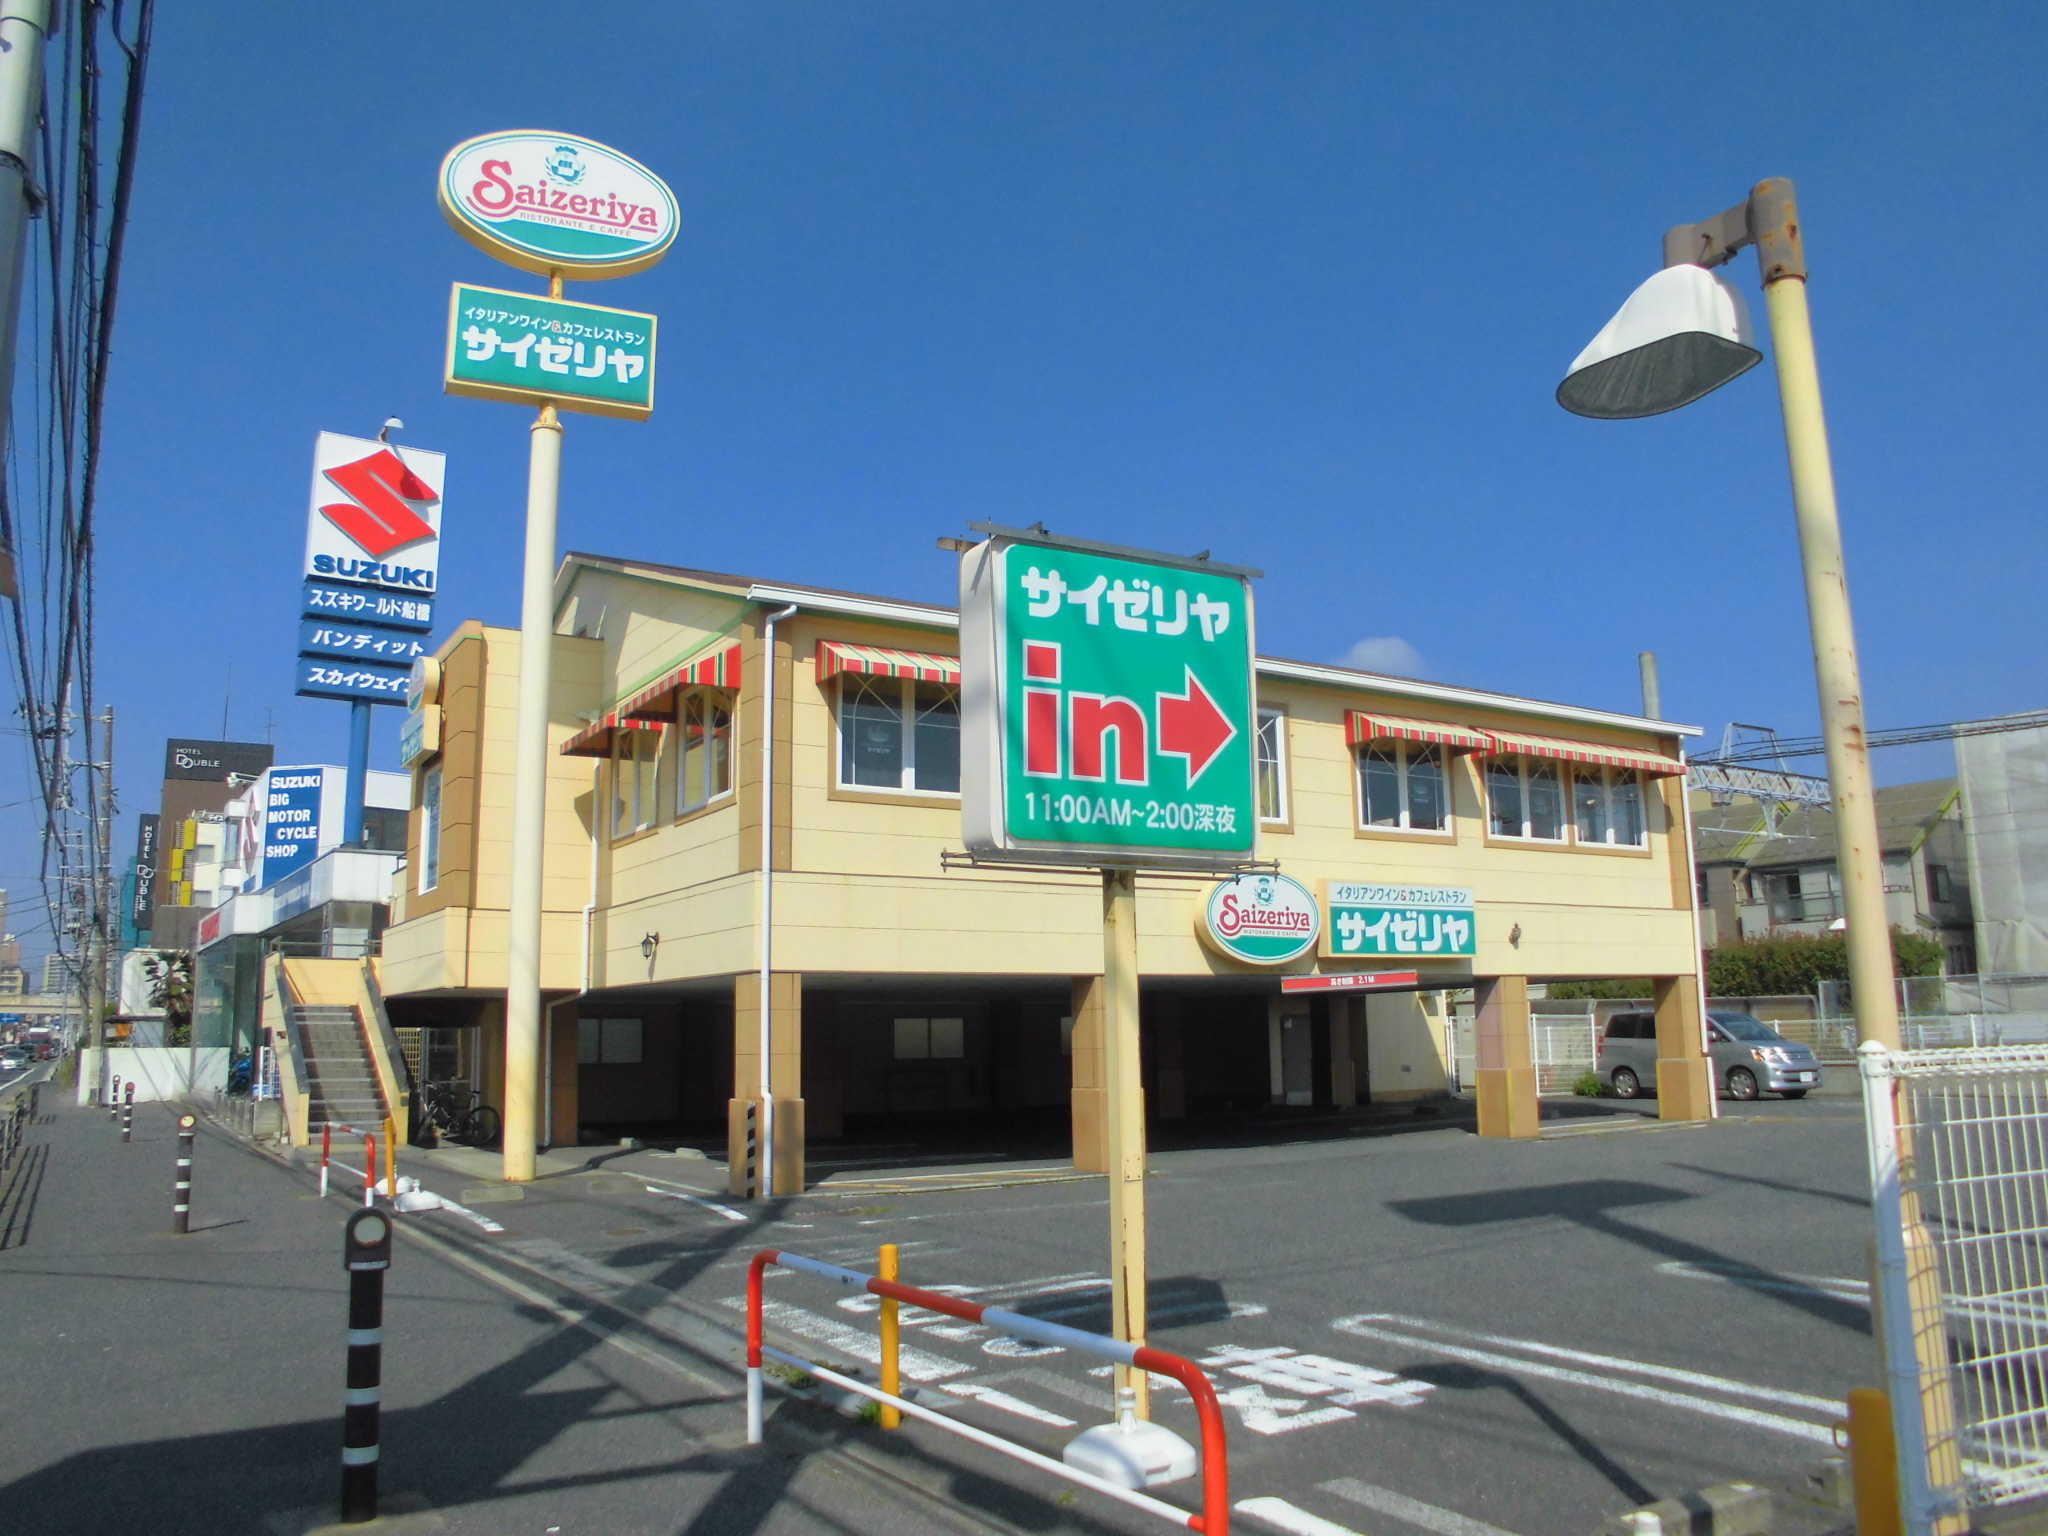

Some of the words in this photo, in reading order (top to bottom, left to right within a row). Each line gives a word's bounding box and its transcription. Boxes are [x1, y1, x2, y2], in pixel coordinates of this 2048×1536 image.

[470, 159, 658, 230] Saizeriya
[519, 211, 584, 230] RISTORANTE
[464, 306, 646, 347] イタリアンワイン&カフェレストラン
[462, 325, 645, 384] サイゼリヤ
[313, 554, 435, 589] SUZUKI
[310, 589, 431, 622] スズキワールド船橋
[1021, 566, 1231, 643] サイゼリヤ
[311, 629, 424, 657] バンディット
[1022, 638, 1149, 787] in
[175, 754, 221, 769] DOUBLE
[270, 775, 321, 789] SUZUKI
[268, 809, 312, 823] MOTOR
[269, 793, 290, 806] BIG
[143, 825, 153, 859] HOTEL
[277, 825, 318, 840] CYCLE
[266, 845, 299, 858] SHOP
[1336, 886, 1467, 904] イタリアンワイン&カフェレストラン
[1218, 894, 1311, 930] Saizeriya
[1336, 910, 1469, 952] サイゼリヤ
